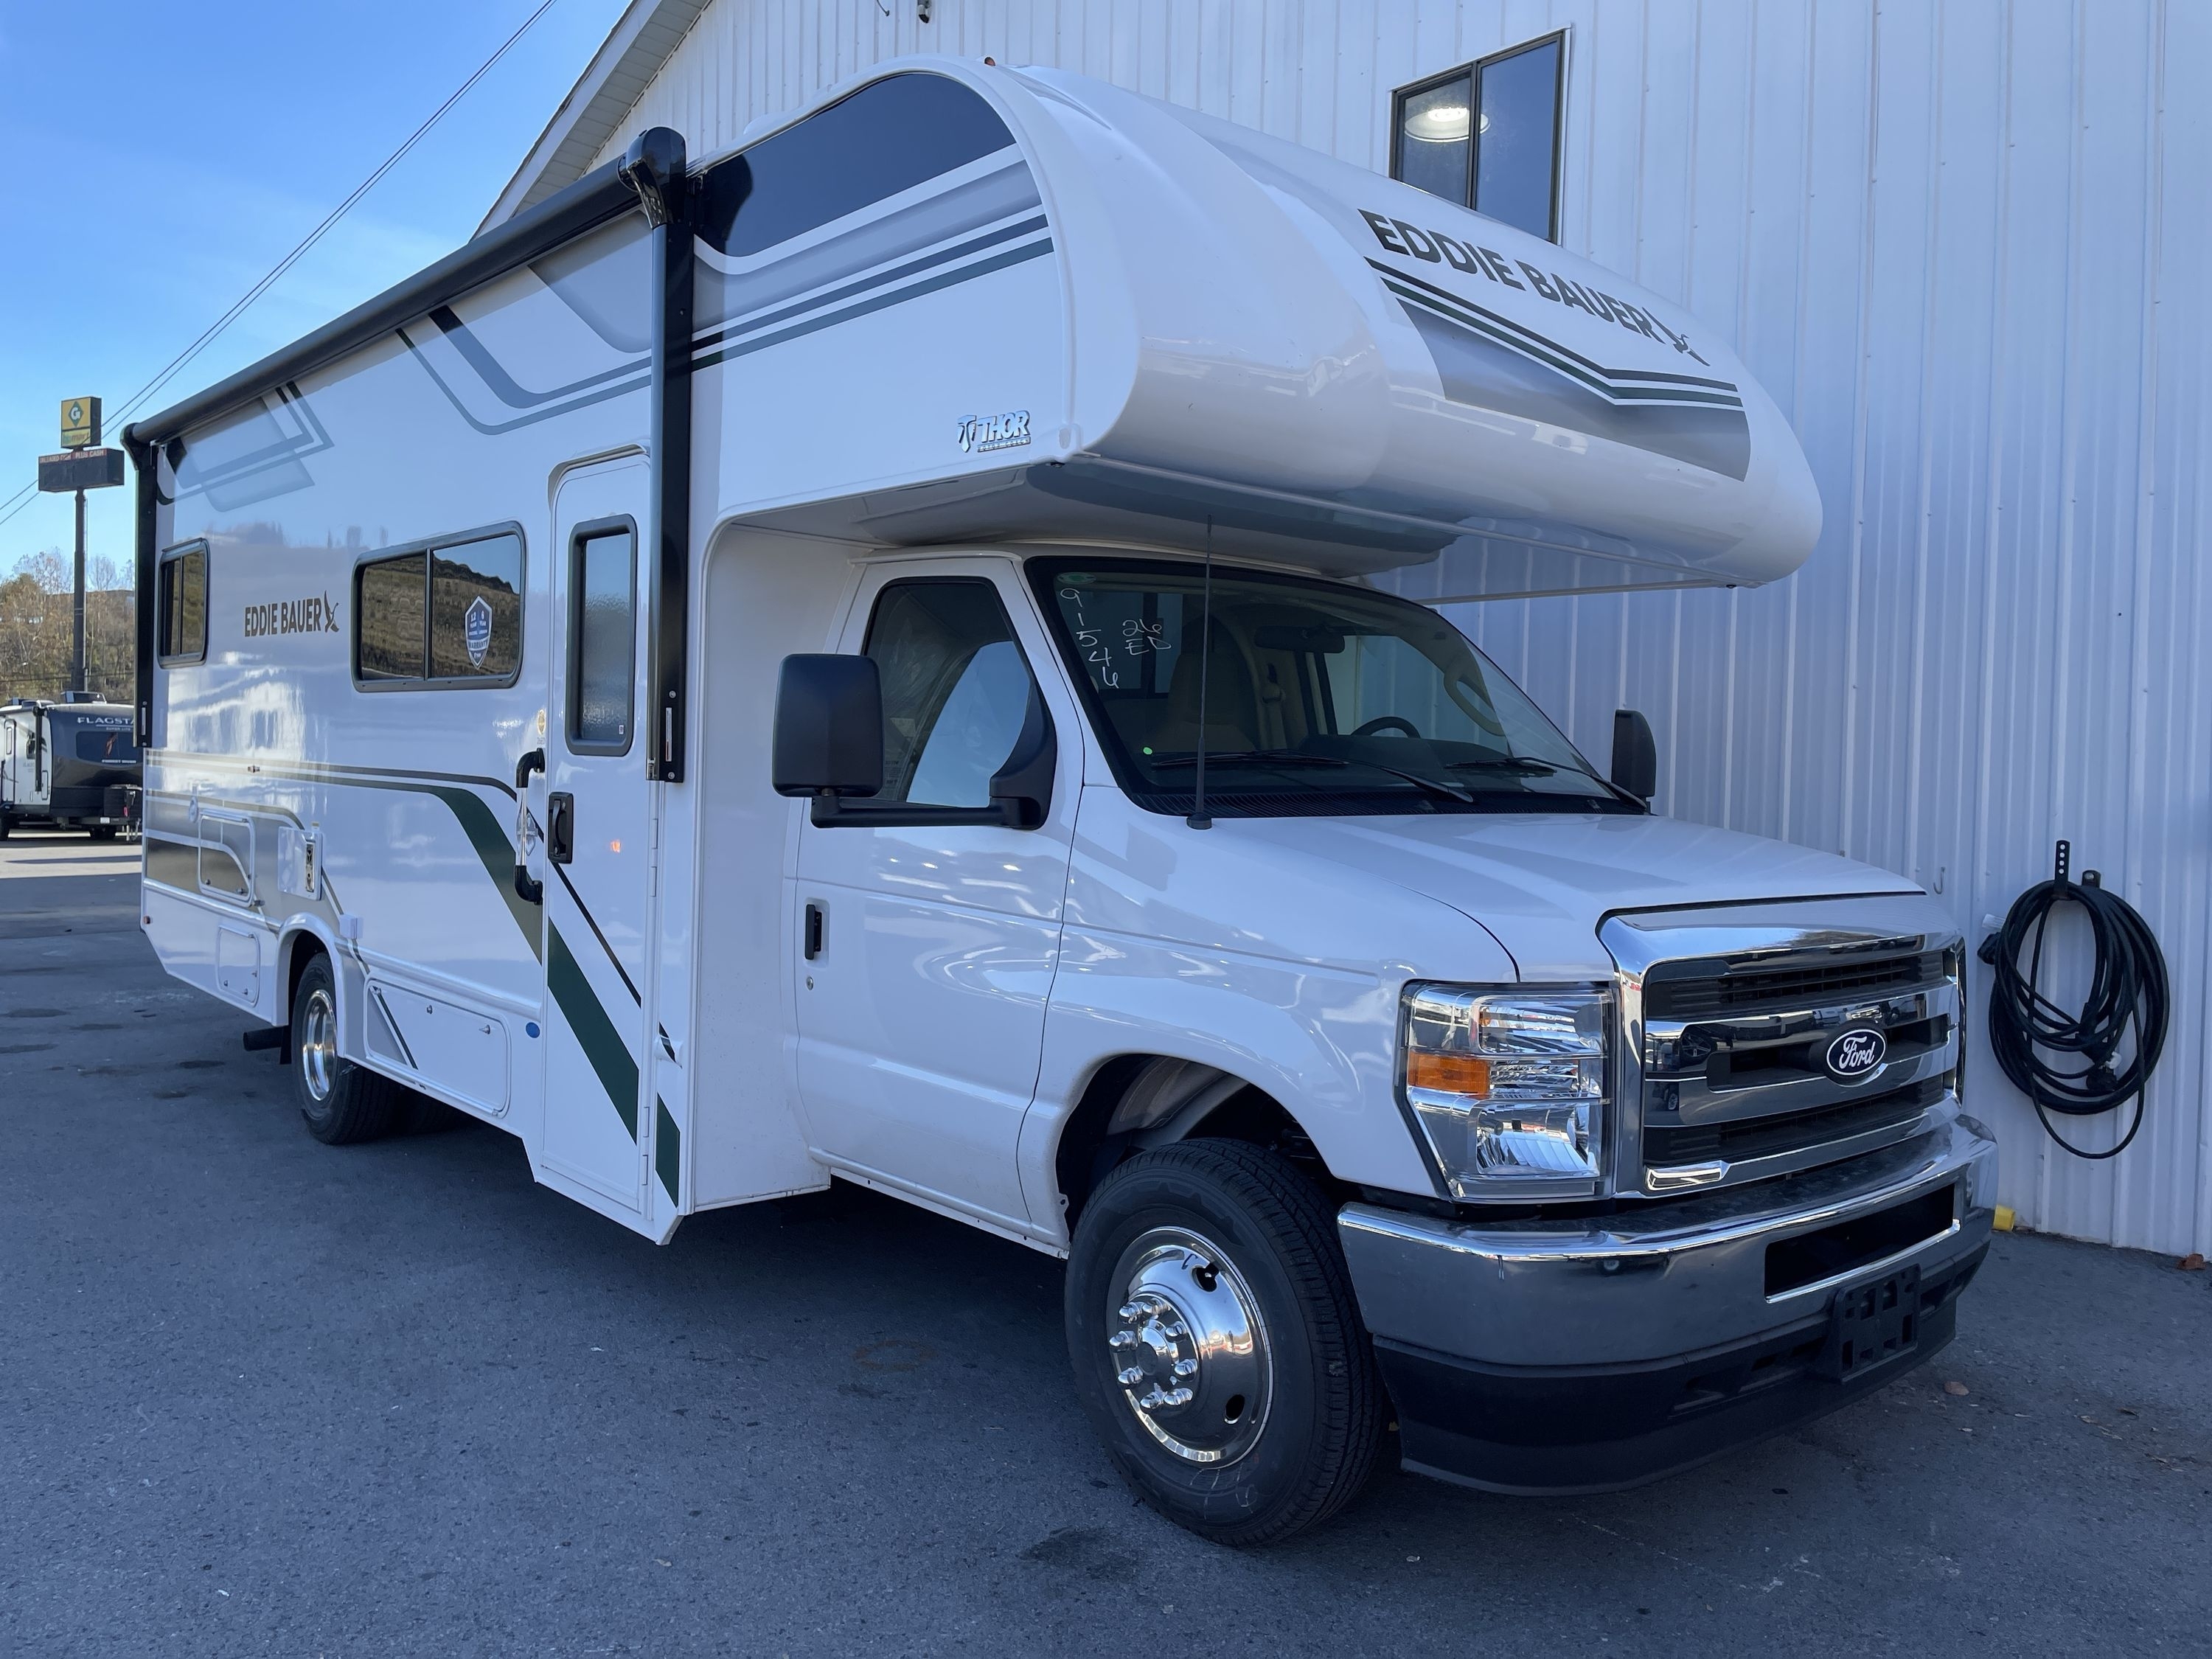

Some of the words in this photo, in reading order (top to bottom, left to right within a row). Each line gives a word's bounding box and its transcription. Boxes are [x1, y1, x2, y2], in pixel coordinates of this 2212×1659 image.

[1357, 209, 1526, 291] EDDIE
[1514, 259, 1665, 344] BAUER
[71, 407, 81, 420] G
[977, 410, 1031, 443] THOR
[89, 448, 104, 457] CASH
[245, 603, 278, 637] EDDIE
[281, 598, 321, 634] BAUER
[1839, 1036, 1876, 1069] Ford
